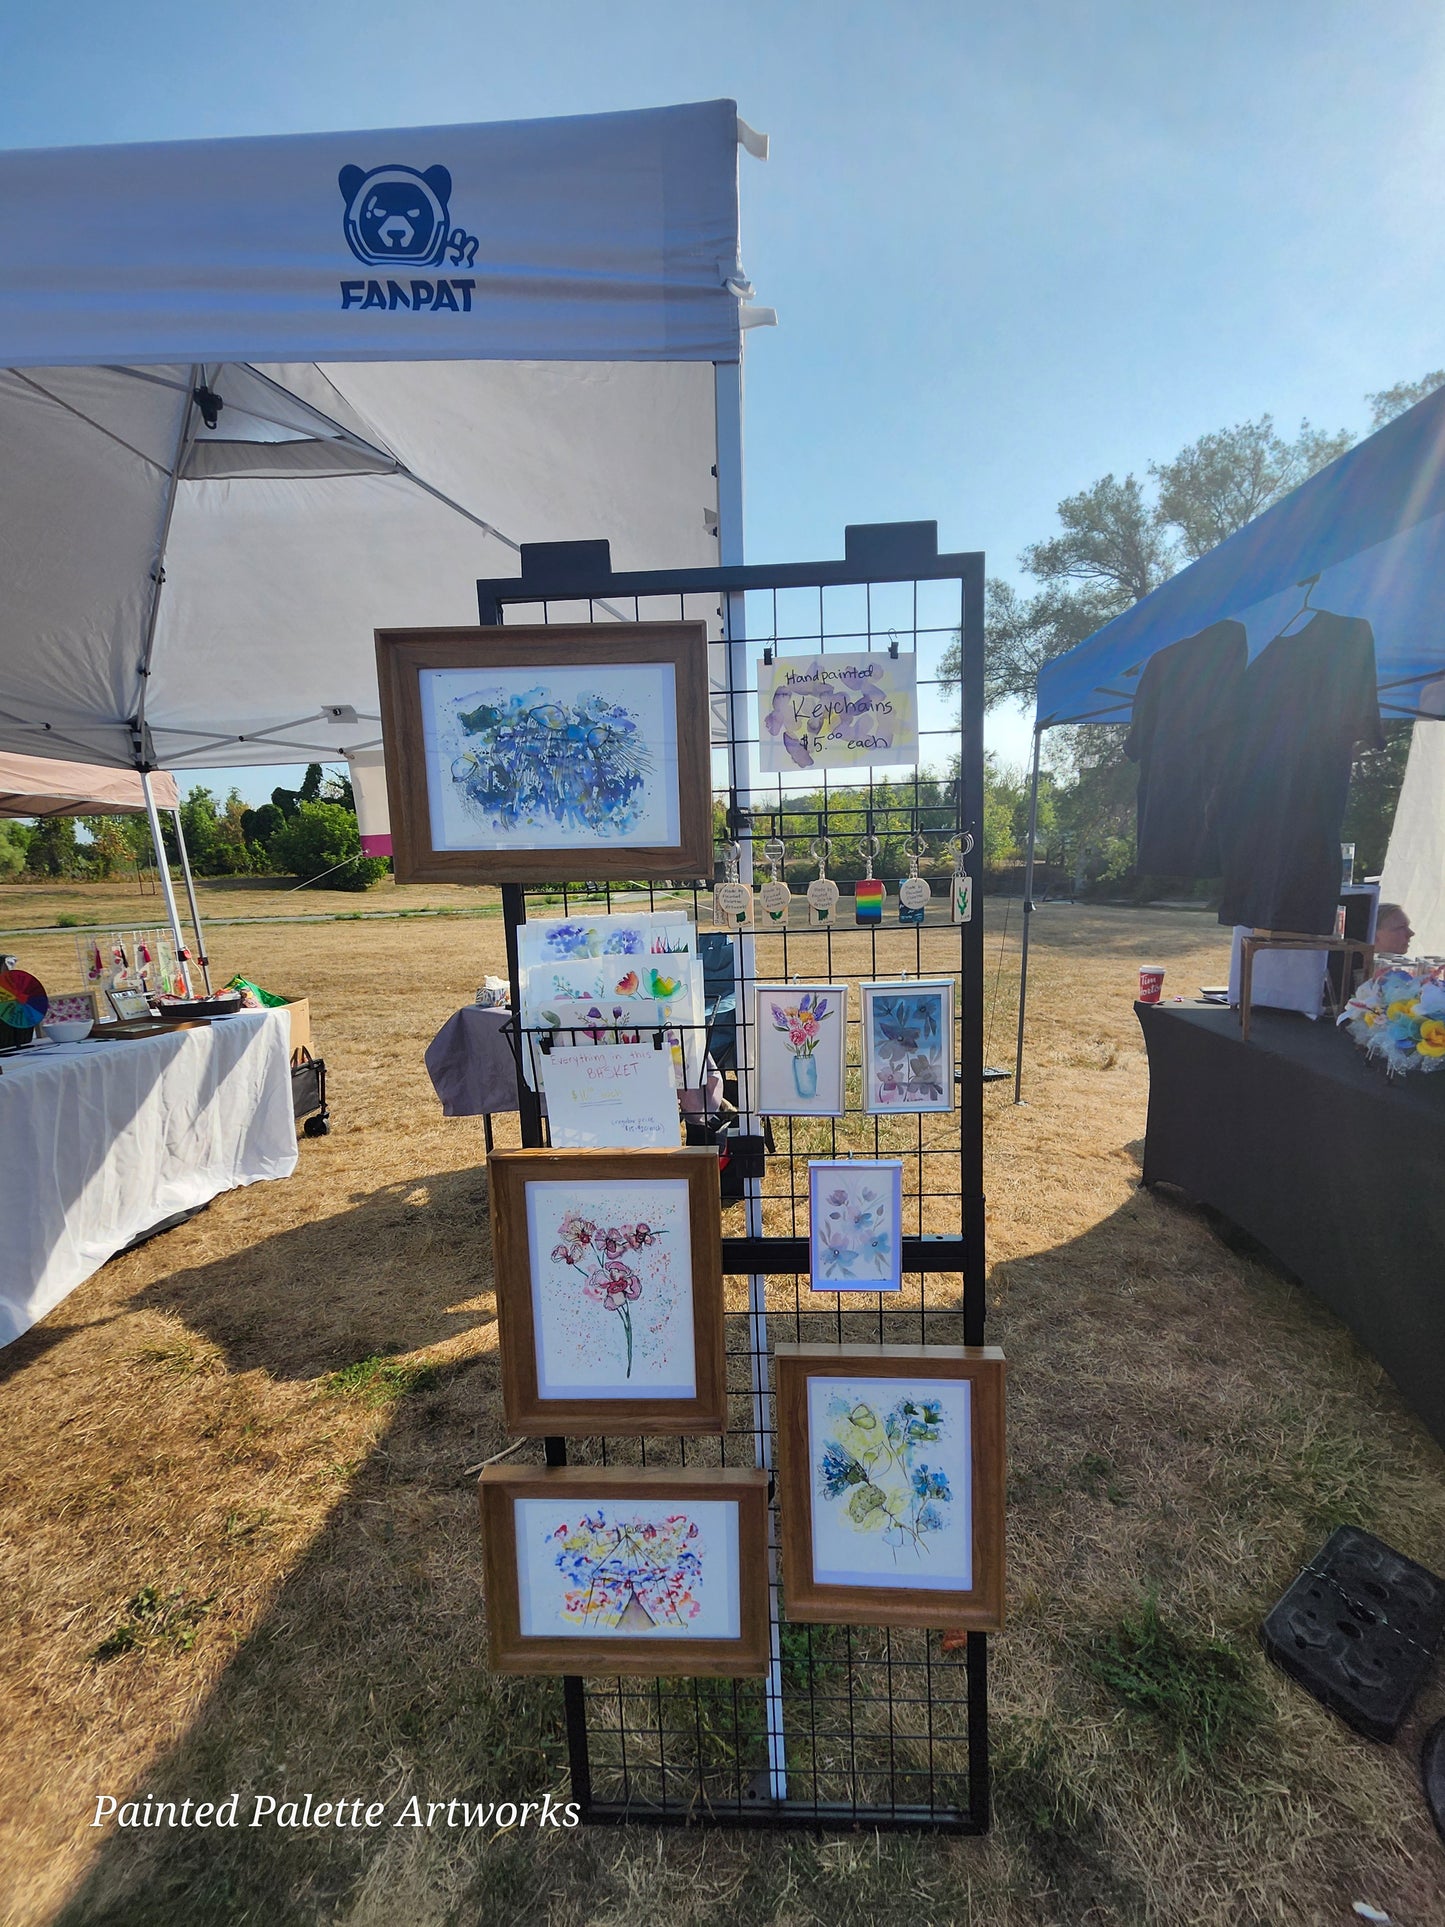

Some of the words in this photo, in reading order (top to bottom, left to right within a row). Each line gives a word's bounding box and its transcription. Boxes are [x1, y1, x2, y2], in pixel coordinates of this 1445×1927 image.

[340, 279, 476, 312] FANPAT
[792, 696, 893, 724] Keychains
[848, 735, 888, 749] each
[1141, 974, 1157, 985] Tim
[551, 1054, 607, 1066] Everything
[630, 1051, 652, 1059] this
[587, 1062, 639, 1079] BASKET
